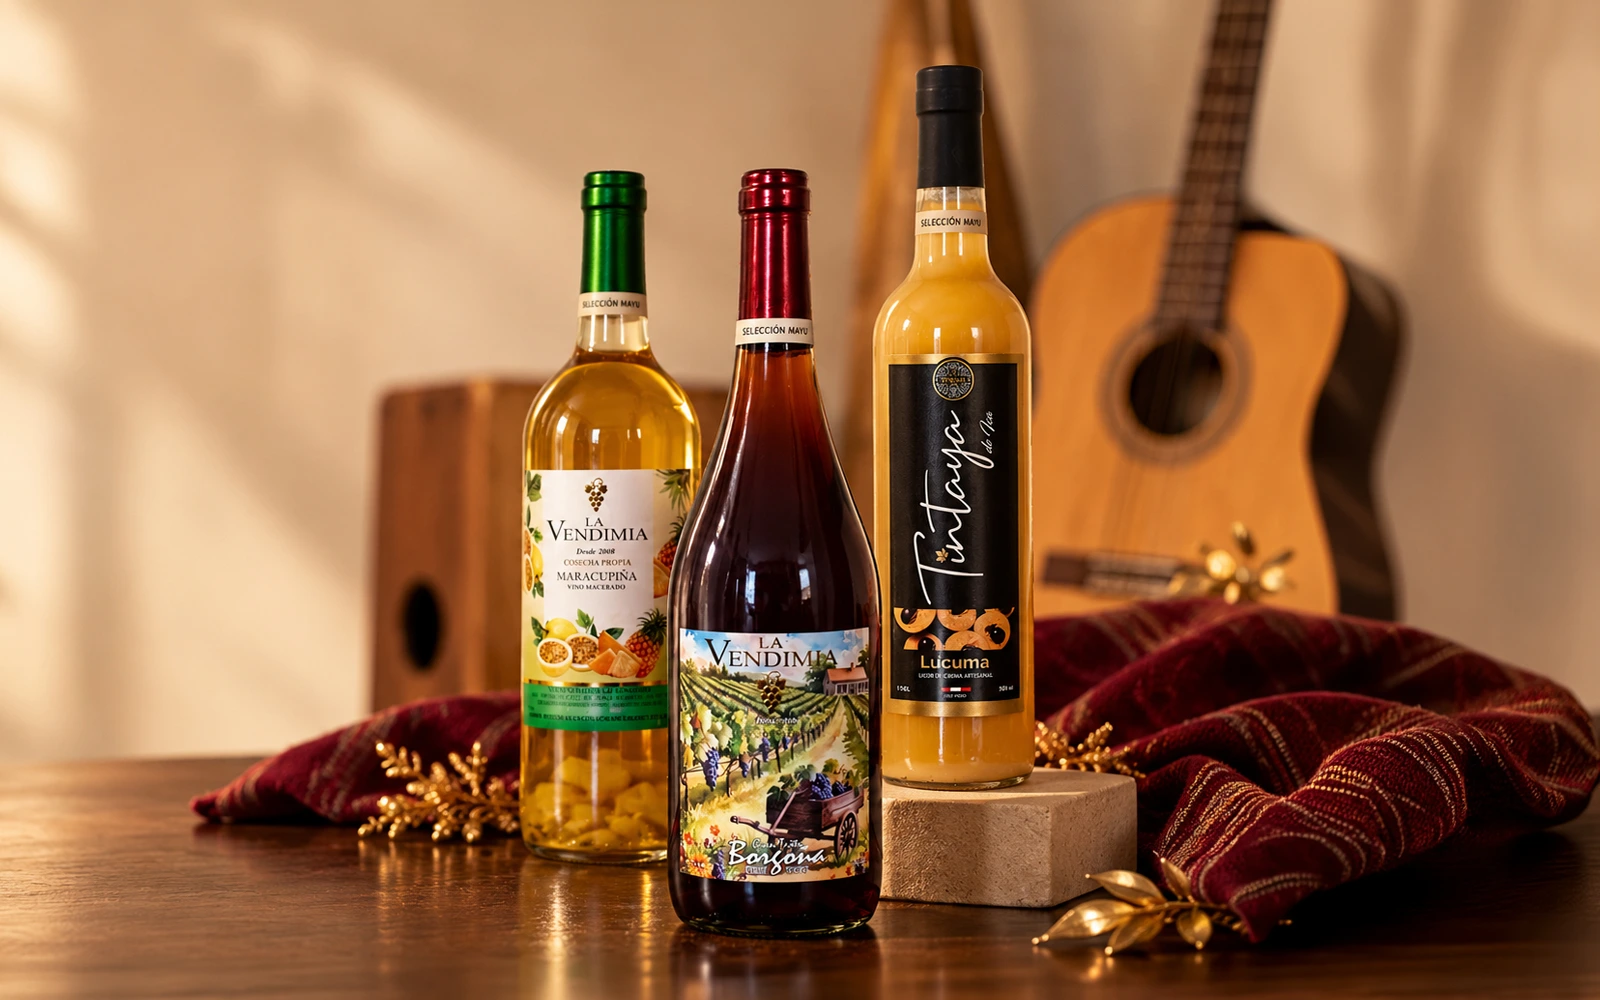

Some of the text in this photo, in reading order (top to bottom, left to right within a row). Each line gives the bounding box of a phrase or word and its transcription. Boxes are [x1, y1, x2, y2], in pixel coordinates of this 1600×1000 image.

[921, 216, 981, 228] SELECCIÓN MAYU
[582, 297, 640, 309] SELECCIÓN MAYU
[742, 324, 808, 336] SELECCIÓN MAYU
[913, 409, 994, 606] Tintaya
[585, 517, 604, 527] LA
[576, 547, 615, 555] Desde 2008
[563, 559, 632, 567] COSECHA PROPIA
[556, 569, 637, 582] MARACUPIÑA
[759, 636, 784, 649] LA
